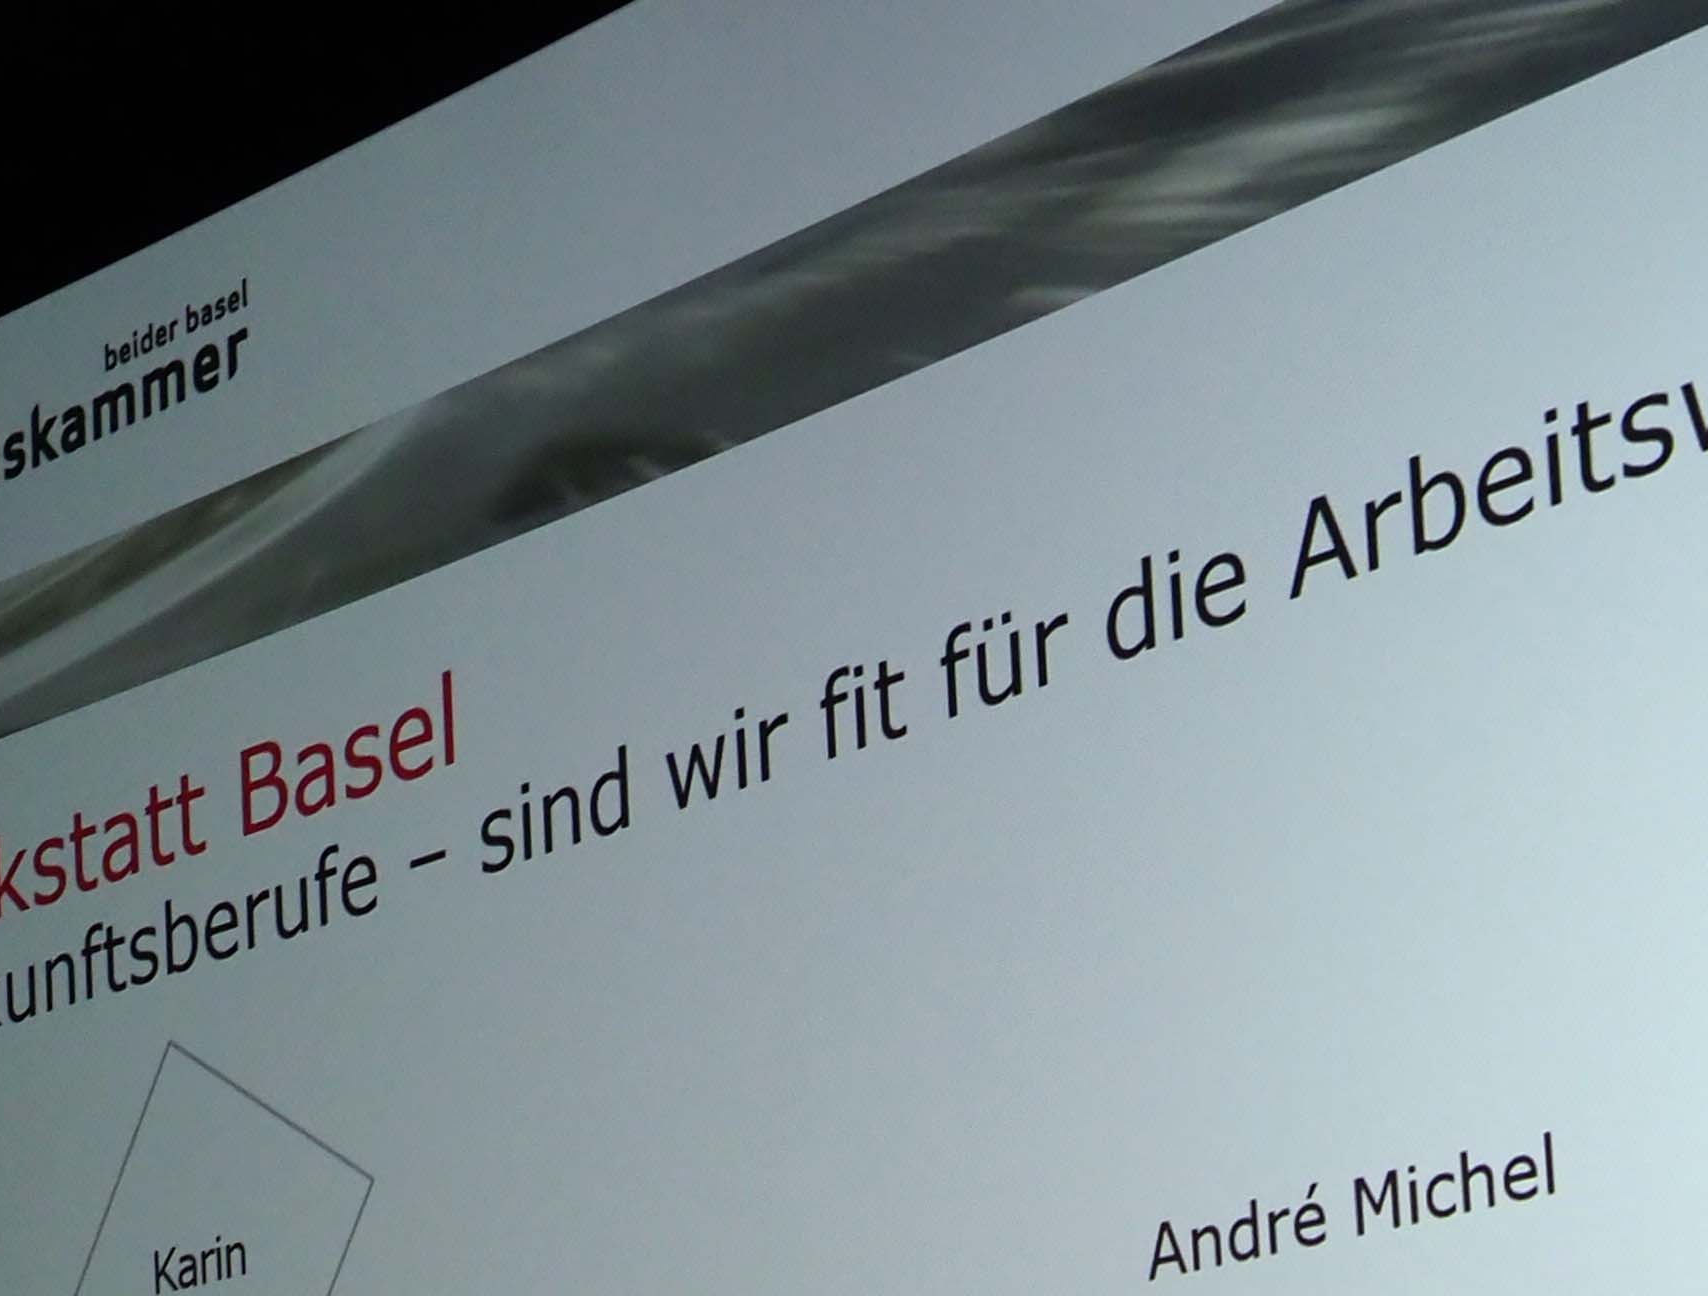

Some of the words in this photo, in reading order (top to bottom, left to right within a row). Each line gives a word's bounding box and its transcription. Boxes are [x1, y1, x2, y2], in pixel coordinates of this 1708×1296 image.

[104, 319, 179, 372] beider
[185, 278, 249, 334] basel
[239, 669, 456, 837] Basel
[479, 745, 630, 873] sind
[665, 706, 789, 810] wir
[819, 660, 908, 760] fit
[939, 611, 1069, 719] für
[1106, 549, 1247, 660] die
[153, 1235, 247, 1296] Karin
[1148, 1182, 1327, 1282] André
[1353, 1131, 1556, 1237] Michel
